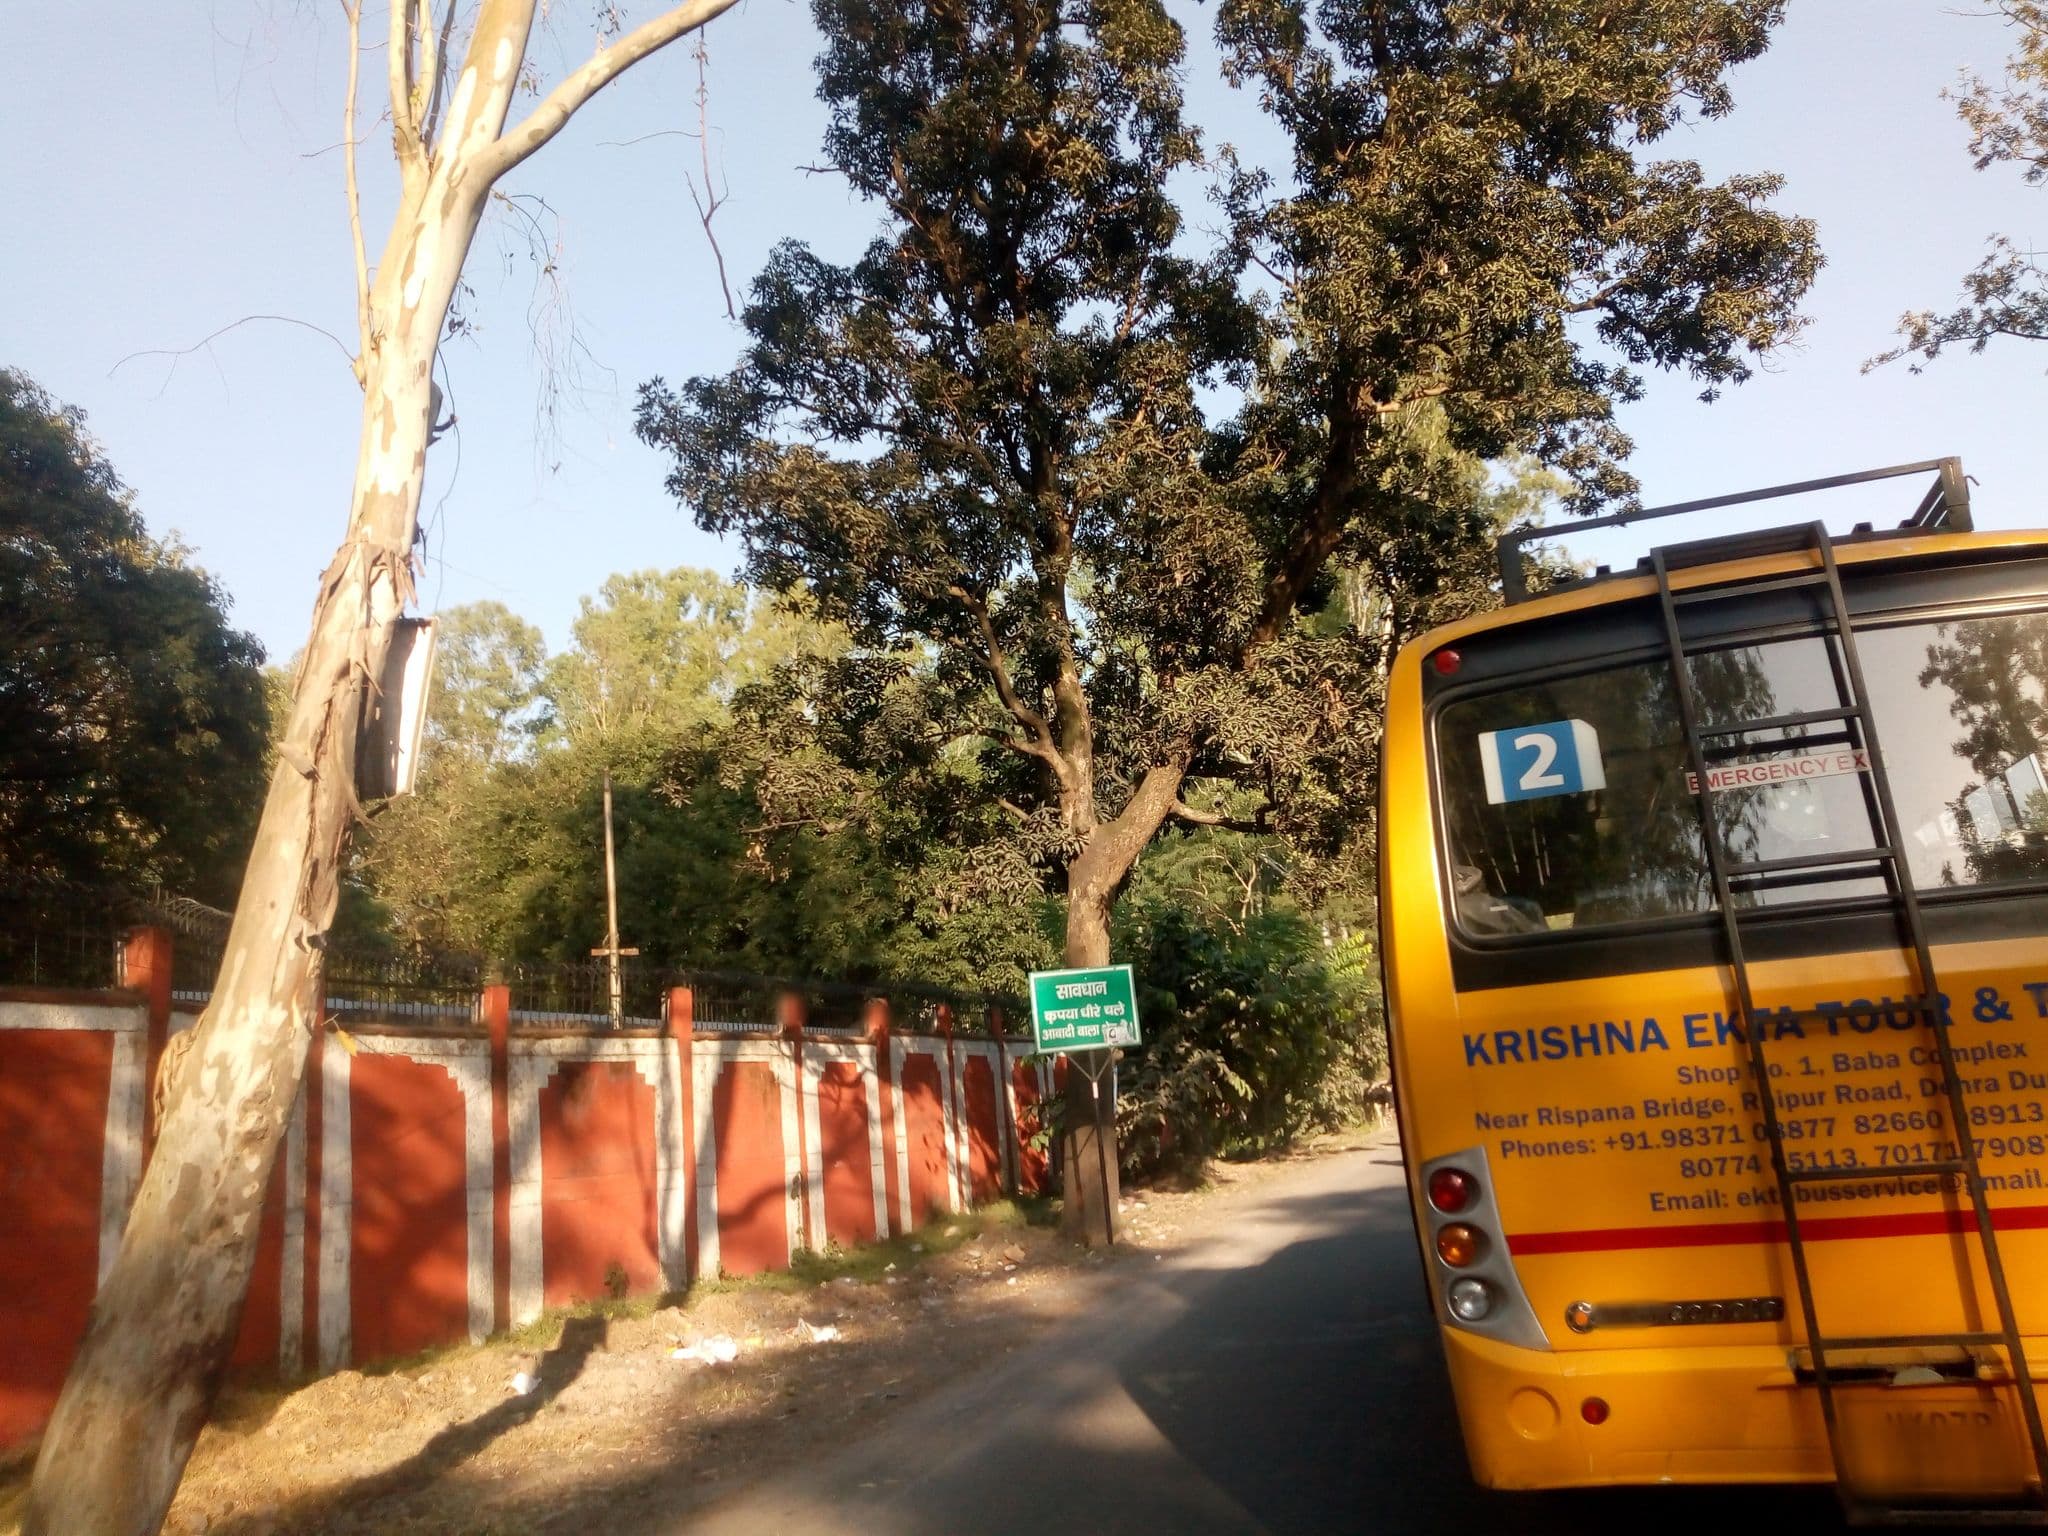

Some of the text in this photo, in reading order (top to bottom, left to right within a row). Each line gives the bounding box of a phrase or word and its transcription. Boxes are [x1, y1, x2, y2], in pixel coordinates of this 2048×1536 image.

[1512, 732, 1565, 791] 2
[1688, 758, 1828, 791] EMERGENCY
[1055, 981, 1108, 1000] सावधान
[1044, 1006, 1079, 1025] कृपया
[1080, 1003, 1101, 1019] धीरे
[1463, 1017, 1670, 1067] KRISHNA
[1683, 1005, 1806, 1049] EKTA
[1815, 991, 1955, 1036] TOUR
[1971, 987, 2014, 1024] &
[1677, 1065, 1740, 1086] Shop
[1750, 1058, 1791, 1080] o.
[1832, 1051, 1901, 1074] Baba
[1909, 1040, 2028, 1067] Complex
[1475, 1111, 1529, 1131] Near
[1537, 1102, 1636, 1128] Rispana
[1643, 1096, 1734, 1120] Bridge,
[1835, 1081, 1912, 1105] Road,
[1501, 1140, 1596, 1160] Phones:
[1854, 1109, 1943, 1135] 82660
[1680, 1154, 1761, 1179] 80774
[1973, 1134, 2048, 1159] 7908
[1649, 1188, 1730, 1213] Email:
